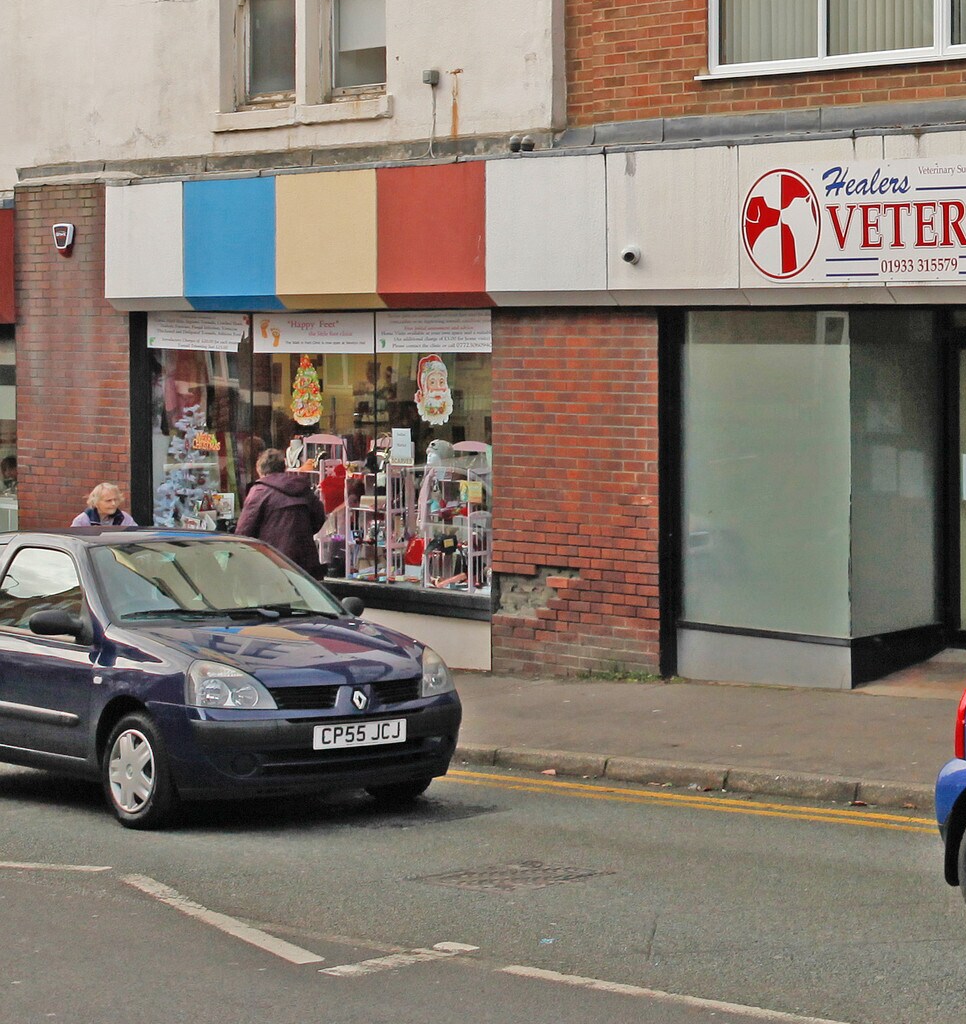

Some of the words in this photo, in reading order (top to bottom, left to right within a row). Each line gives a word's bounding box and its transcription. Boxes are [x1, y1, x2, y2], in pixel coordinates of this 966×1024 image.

[918, 166, 956, 176] Veterinary
[822, 166, 911, 197] Healers
[881, 260, 914, 273] 01933
[917, 258, 958, 272] 315579
[321, 725, 366, 744] CP55
[371, 722, 401, 741] JCJ
